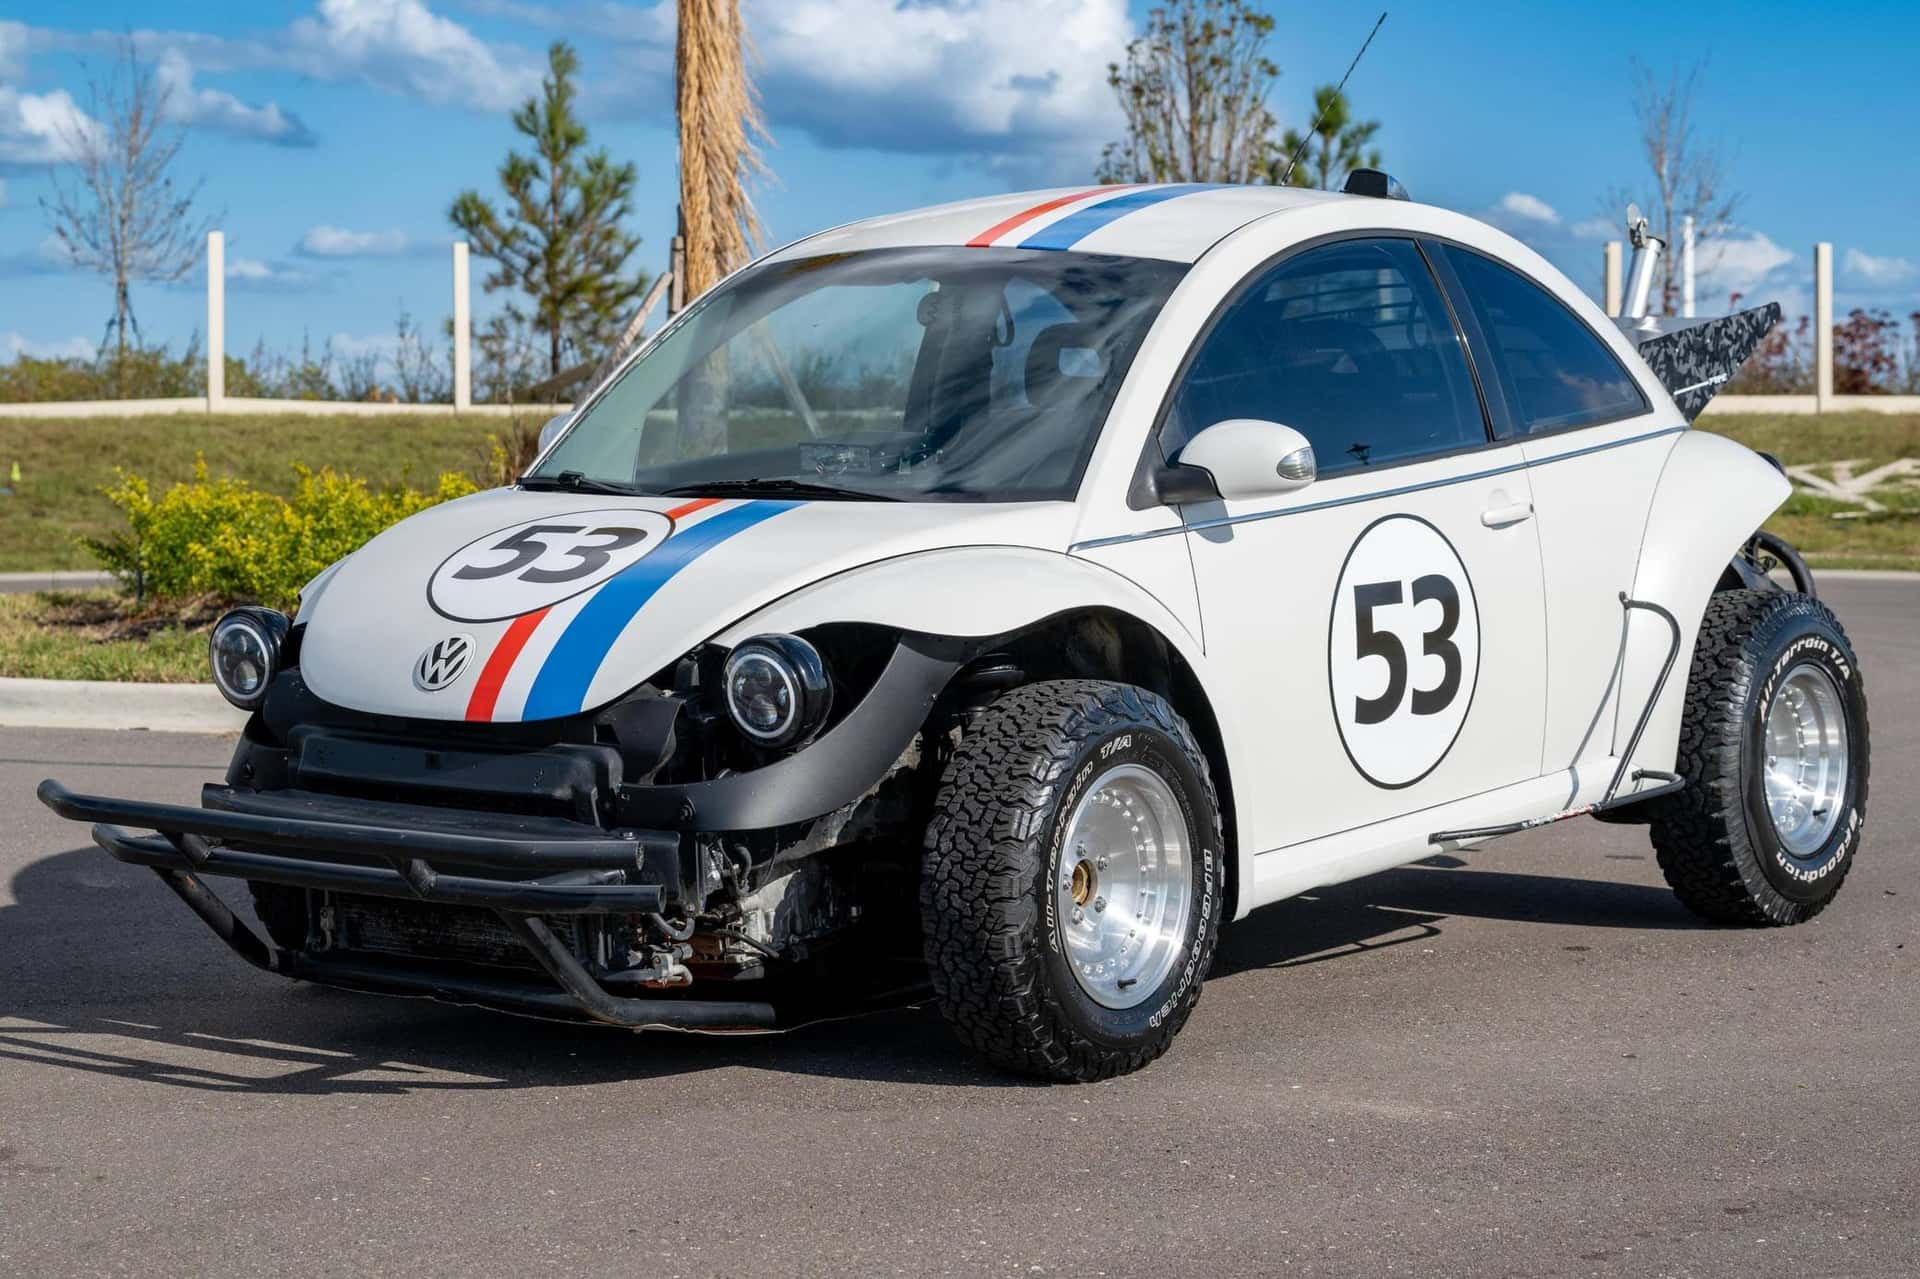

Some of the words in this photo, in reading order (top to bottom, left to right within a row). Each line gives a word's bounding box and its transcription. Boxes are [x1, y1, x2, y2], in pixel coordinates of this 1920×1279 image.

[451, 524, 649, 584] 53
[417, 635, 470, 687] VW
[1353, 574, 1463, 725] 53
[1830, 647, 1850, 681] T/A
[1100, 734, 1132, 760] T/A
[1149, 848, 1213, 1028] BFGoodrich
